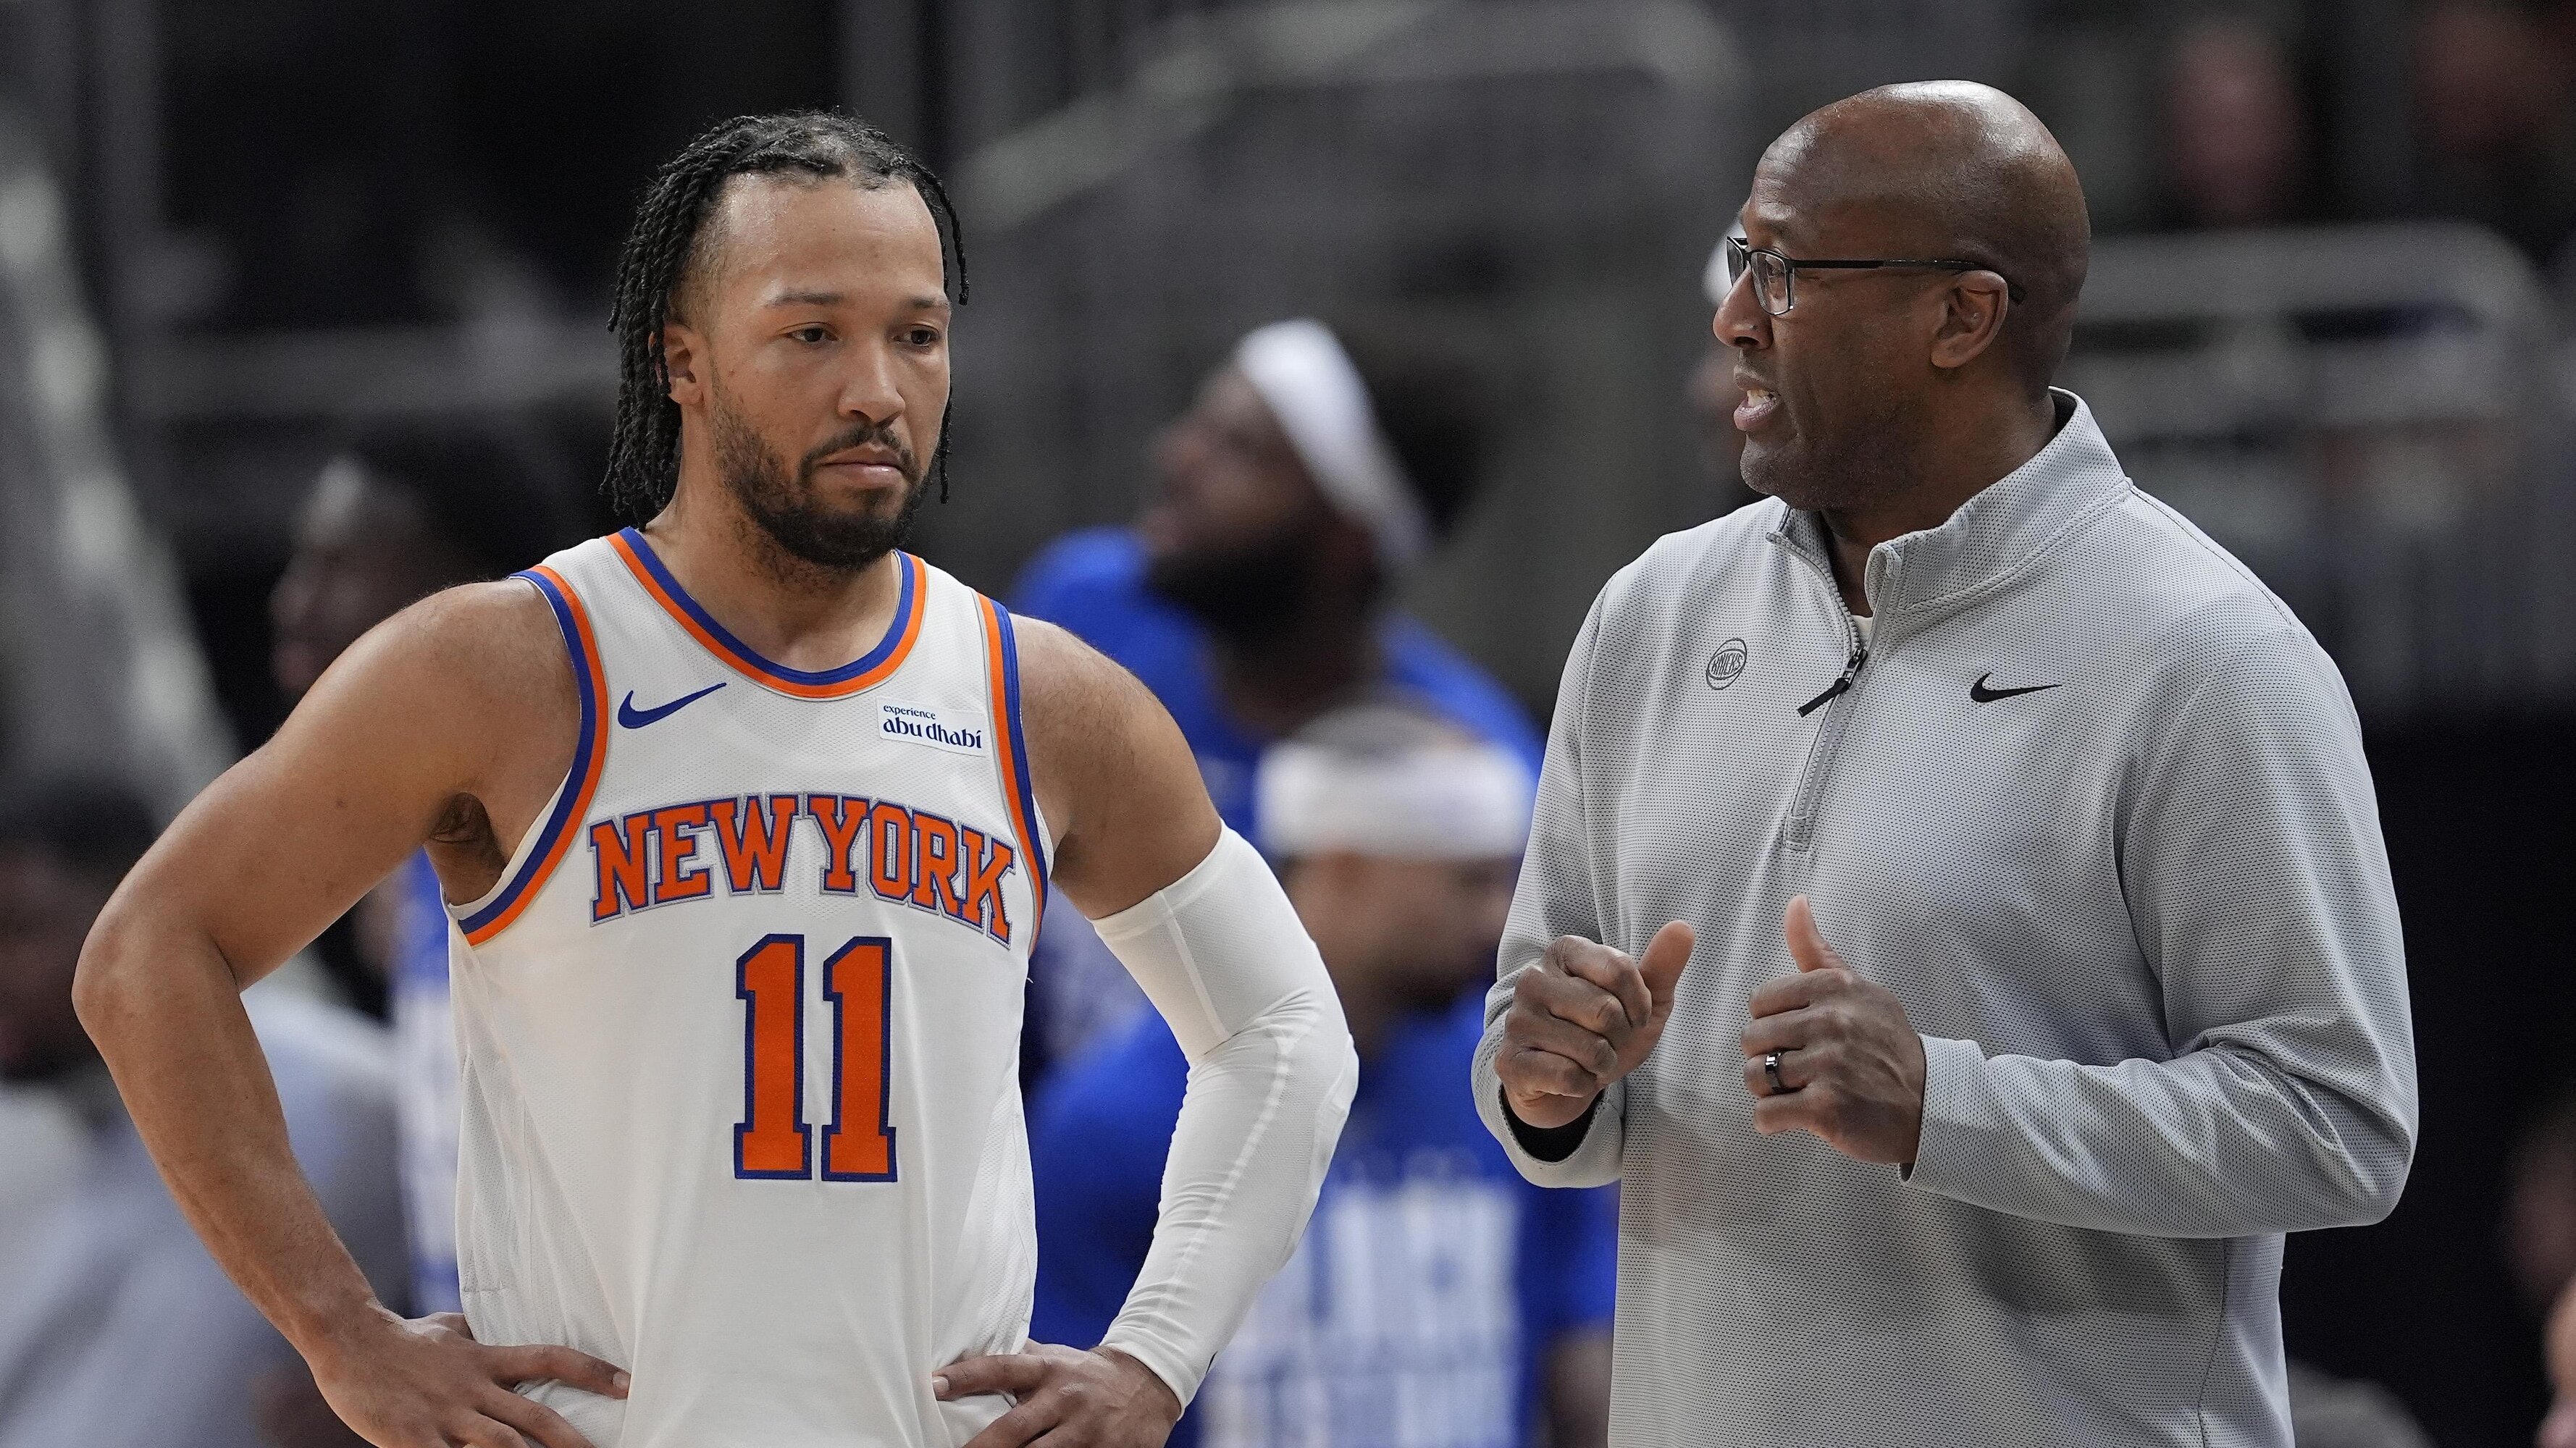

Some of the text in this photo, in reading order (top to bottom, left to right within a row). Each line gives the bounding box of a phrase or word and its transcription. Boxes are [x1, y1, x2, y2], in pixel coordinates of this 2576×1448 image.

[883, 717, 982, 749] abu dhabi
[884, 704, 936, 720] experience
[587, 791, 1016, 950] NEW YORK
[733, 933, 898, 1182] 11
